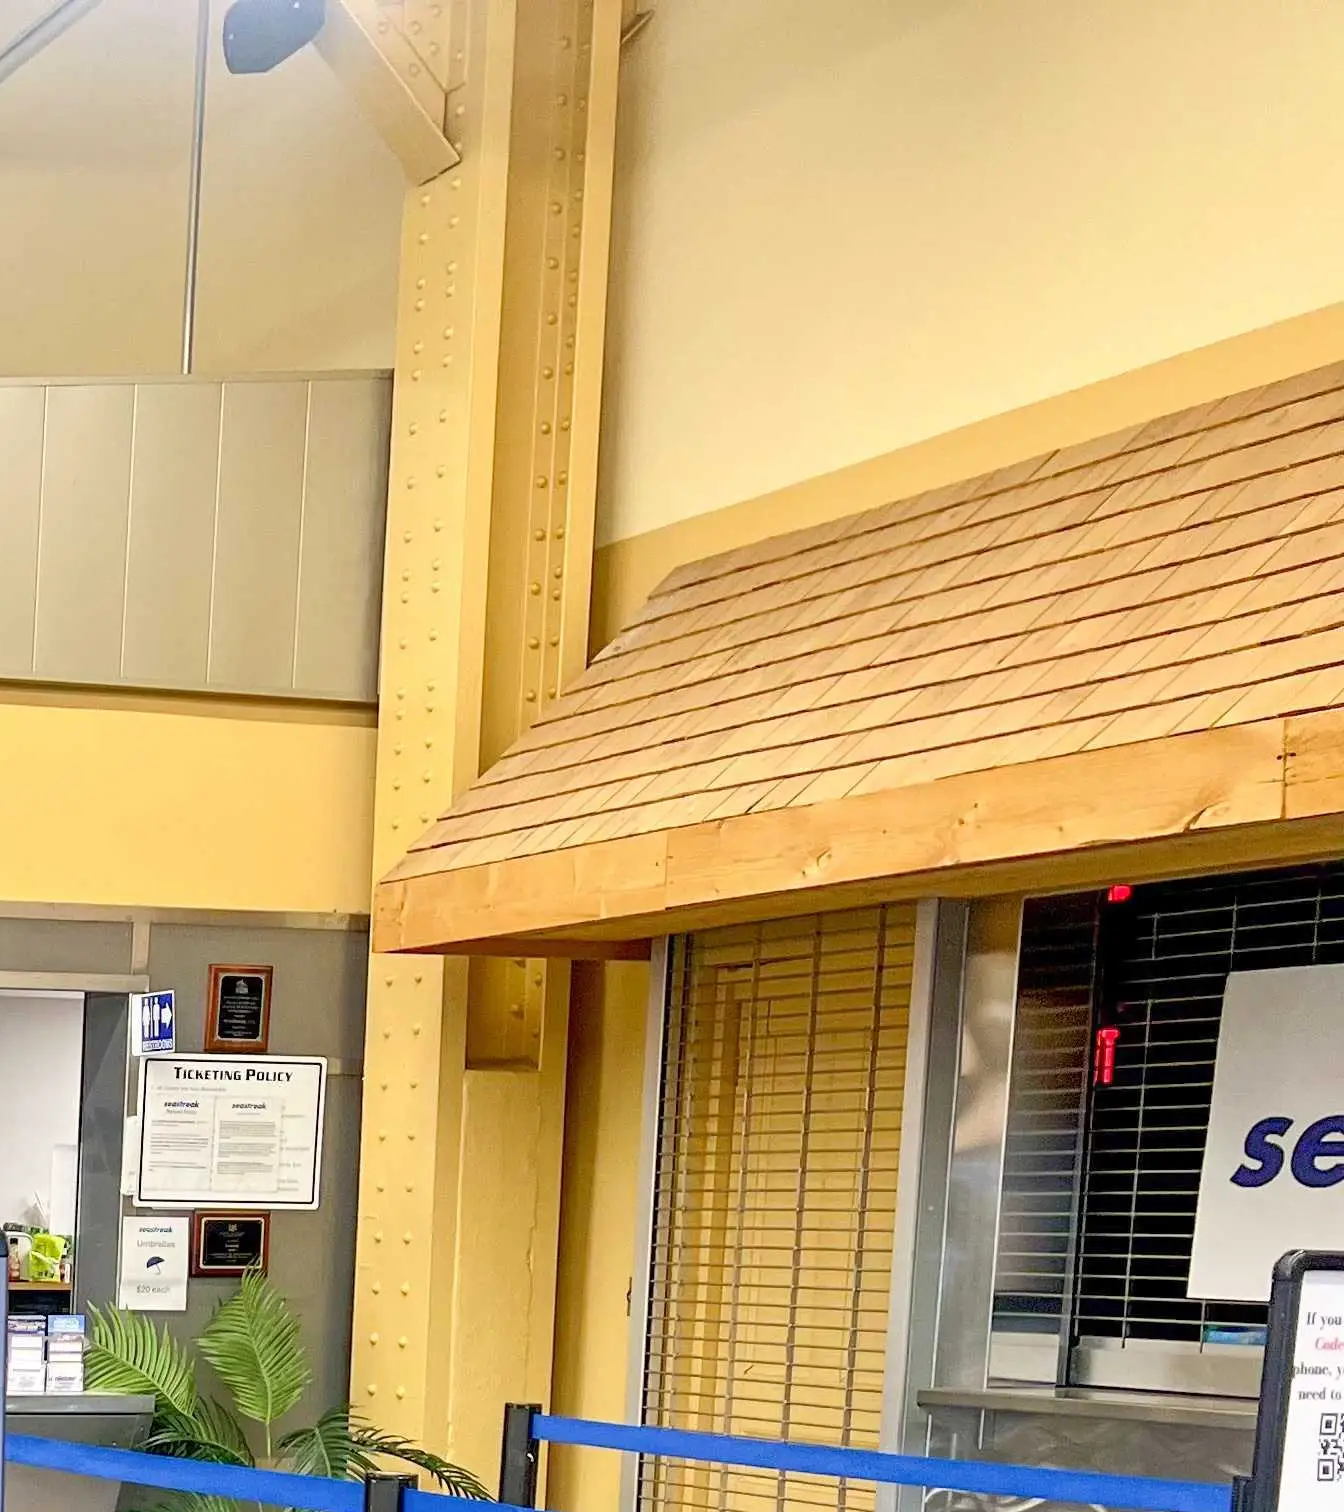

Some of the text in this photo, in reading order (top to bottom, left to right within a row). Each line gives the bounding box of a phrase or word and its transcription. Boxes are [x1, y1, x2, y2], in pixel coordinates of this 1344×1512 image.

[164, 1100, 199, 1108] seastreak
[232, 1102, 266, 1110] seastreak
[137, 1240, 176, 1248] Umbrellas
[136, 1285, 150, 1294] $20
[1306, 1312, 1342, 1330] If you
[1299, 1387, 1341, 1400] need to
